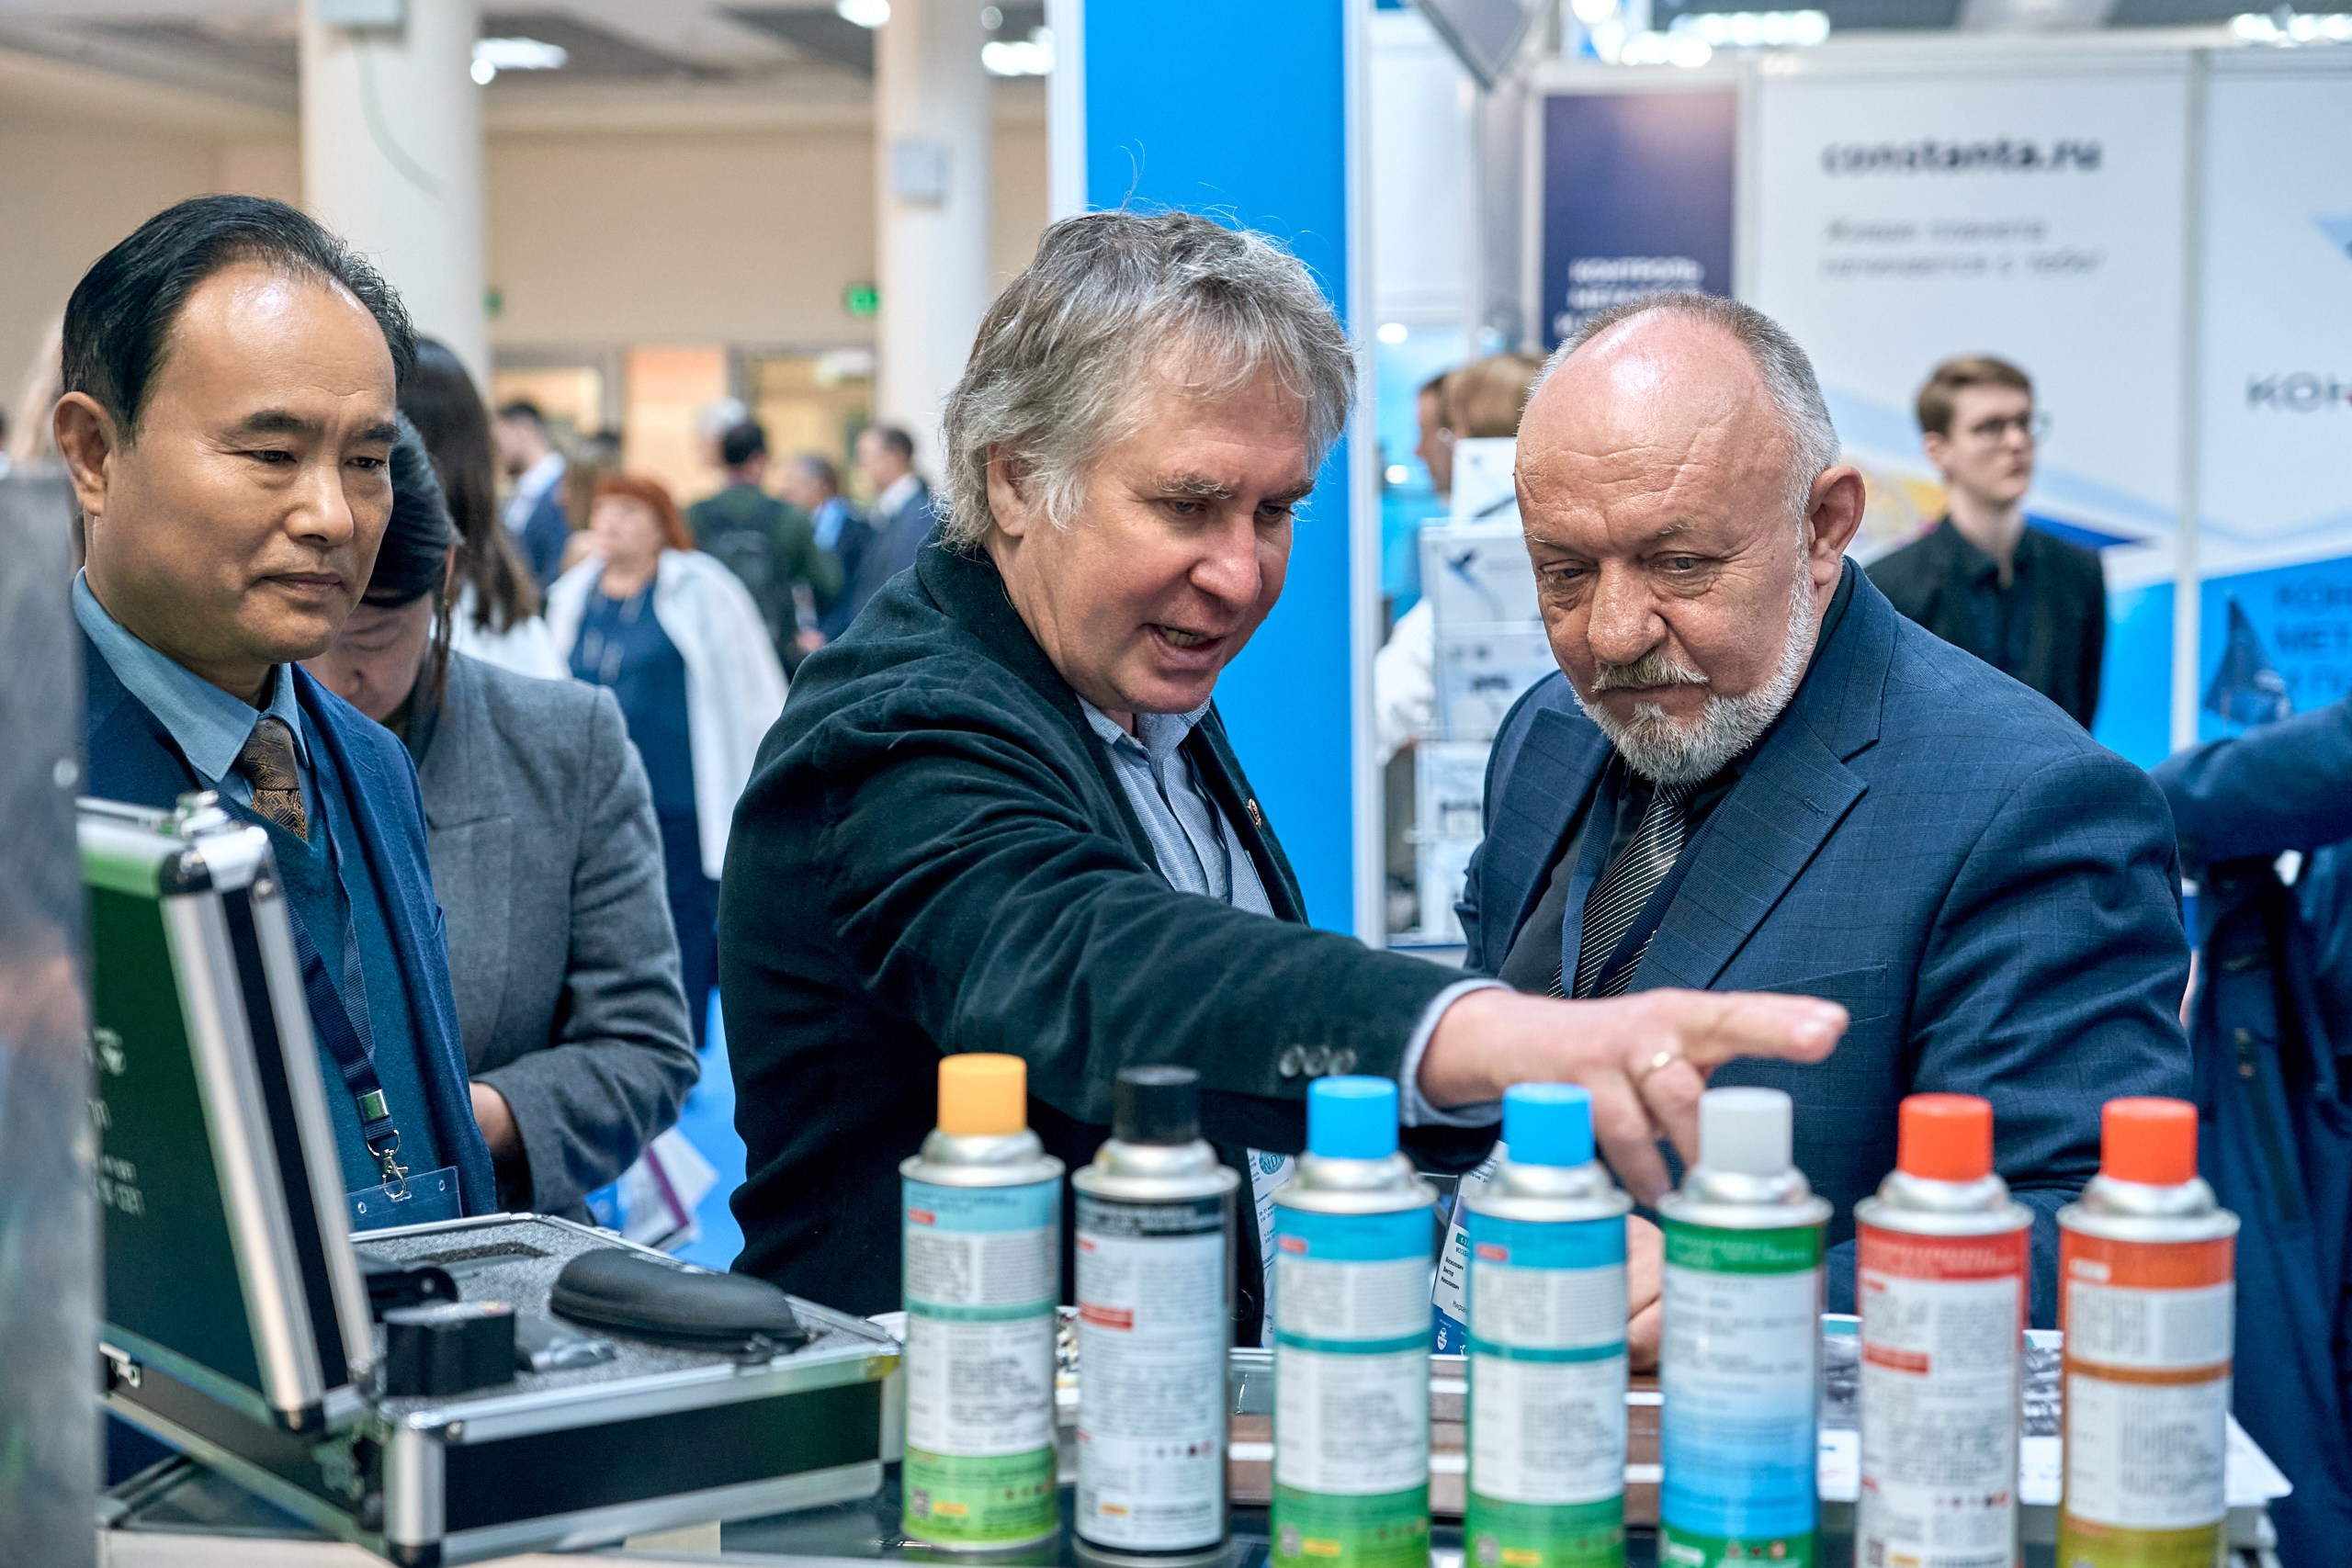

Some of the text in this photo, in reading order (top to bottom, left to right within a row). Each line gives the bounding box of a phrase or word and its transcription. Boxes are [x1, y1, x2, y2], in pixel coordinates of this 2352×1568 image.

[1821, 138, 2103, 175] constanta.ru
[1442, 1266, 1454, 1278] Виктор
[1441, 1277, 1460, 1290] Николаевич
